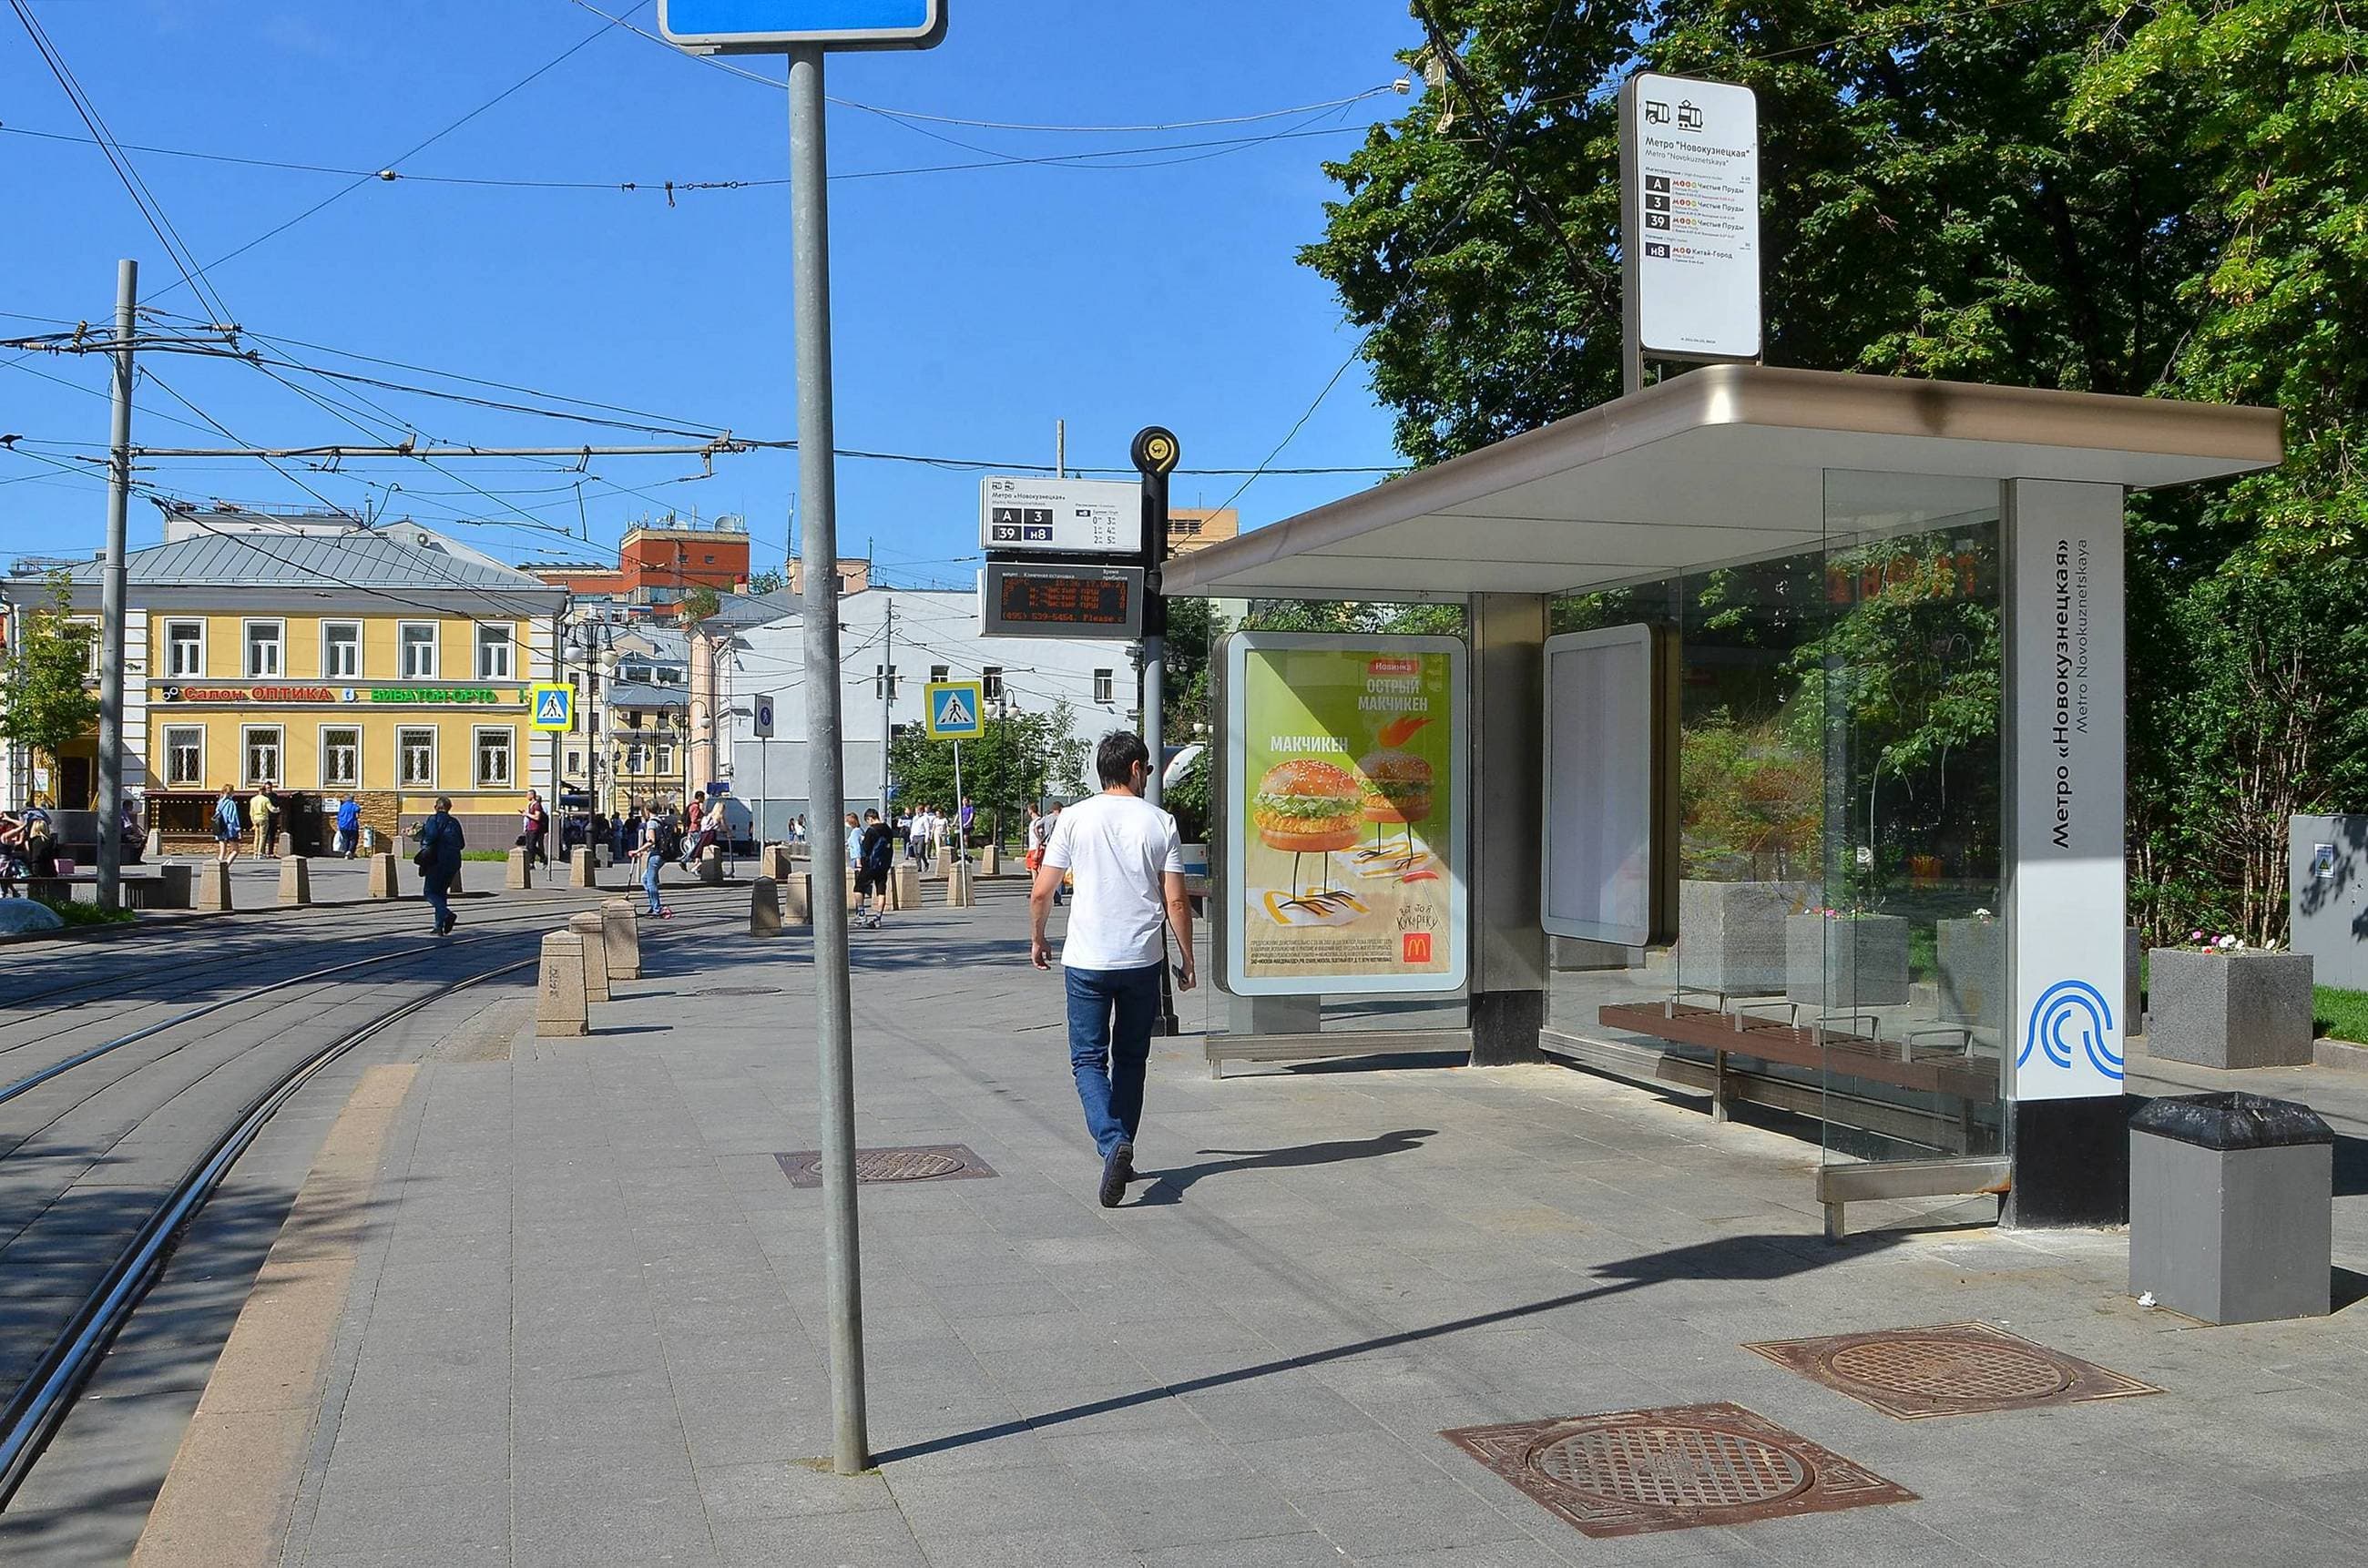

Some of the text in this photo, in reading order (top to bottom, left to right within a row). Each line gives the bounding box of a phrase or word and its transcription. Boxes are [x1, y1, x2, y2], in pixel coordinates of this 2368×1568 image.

[1645, 136, 1674, 149] Метро
[1645, 149, 1666, 159] Metro
[1654, 197, 1661, 208] 3
[1650, 216, 1665, 227] 39
[1650, 246, 1665, 257] н8
[1035, 511, 1043, 523] 3
[999, 527, 1046, 540] 39 н8
[2076, 538, 2090, 734] Metro Novokuznetskaya
[1375, 662, 1412, 671] Новинка
[1366, 677, 1419, 694] ОСТРЫЙ
[184, 687, 331, 700] Салон ОПТИКА
[2052, 538, 2074, 849] Метро «Новокузнецкая»
[1358, 696, 1428, 711] МАКЧИКЕН
[1270, 736, 1348, 753] МАКЧИКЕН
